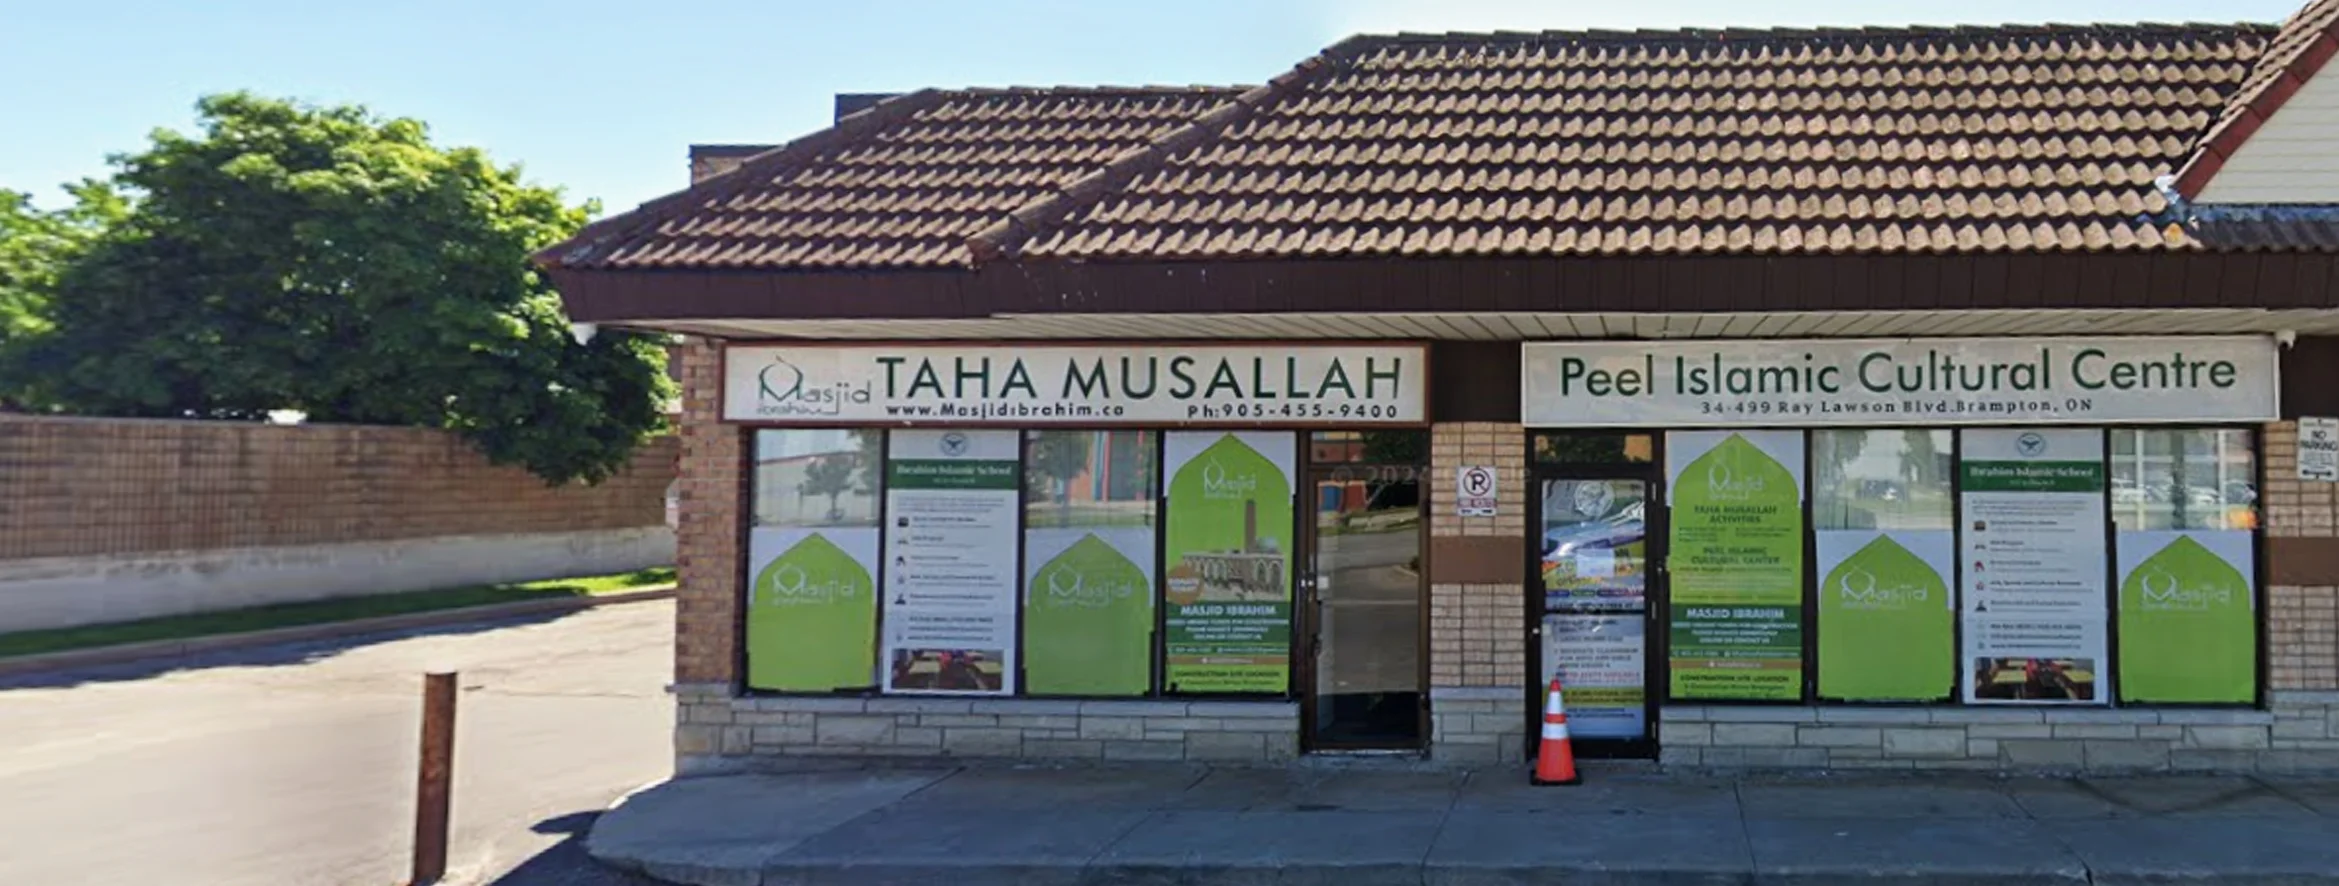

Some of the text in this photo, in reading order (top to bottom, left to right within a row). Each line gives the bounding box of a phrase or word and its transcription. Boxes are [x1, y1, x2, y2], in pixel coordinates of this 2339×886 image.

[877, 356, 1401, 400] TAHA MUSALLAH
[1561, 348, 2237, 396] Peel Islamic Cultural Centre
[759, 356, 871, 413] Masjid
[886, 402, 1124, 419] www.Masjidibrahim.ca
[1188, 403, 1398, 419] Ph:905-455-9400
[1701, 401, 1771, 414] 34-499
[1779, 401, 1814, 415] Ray
[1821, 400, 1895, 413] Lawson
[2066, 398, 2093, 411] ON
[2312, 430, 2327, 440] NO
[977, 465, 1012, 475] School
[2057, 467, 2093, 476] School
[1180, 605, 1277, 615] MASJID IBRAHIM
[1686, 608, 1784, 618] MASJID IBRAHIM
